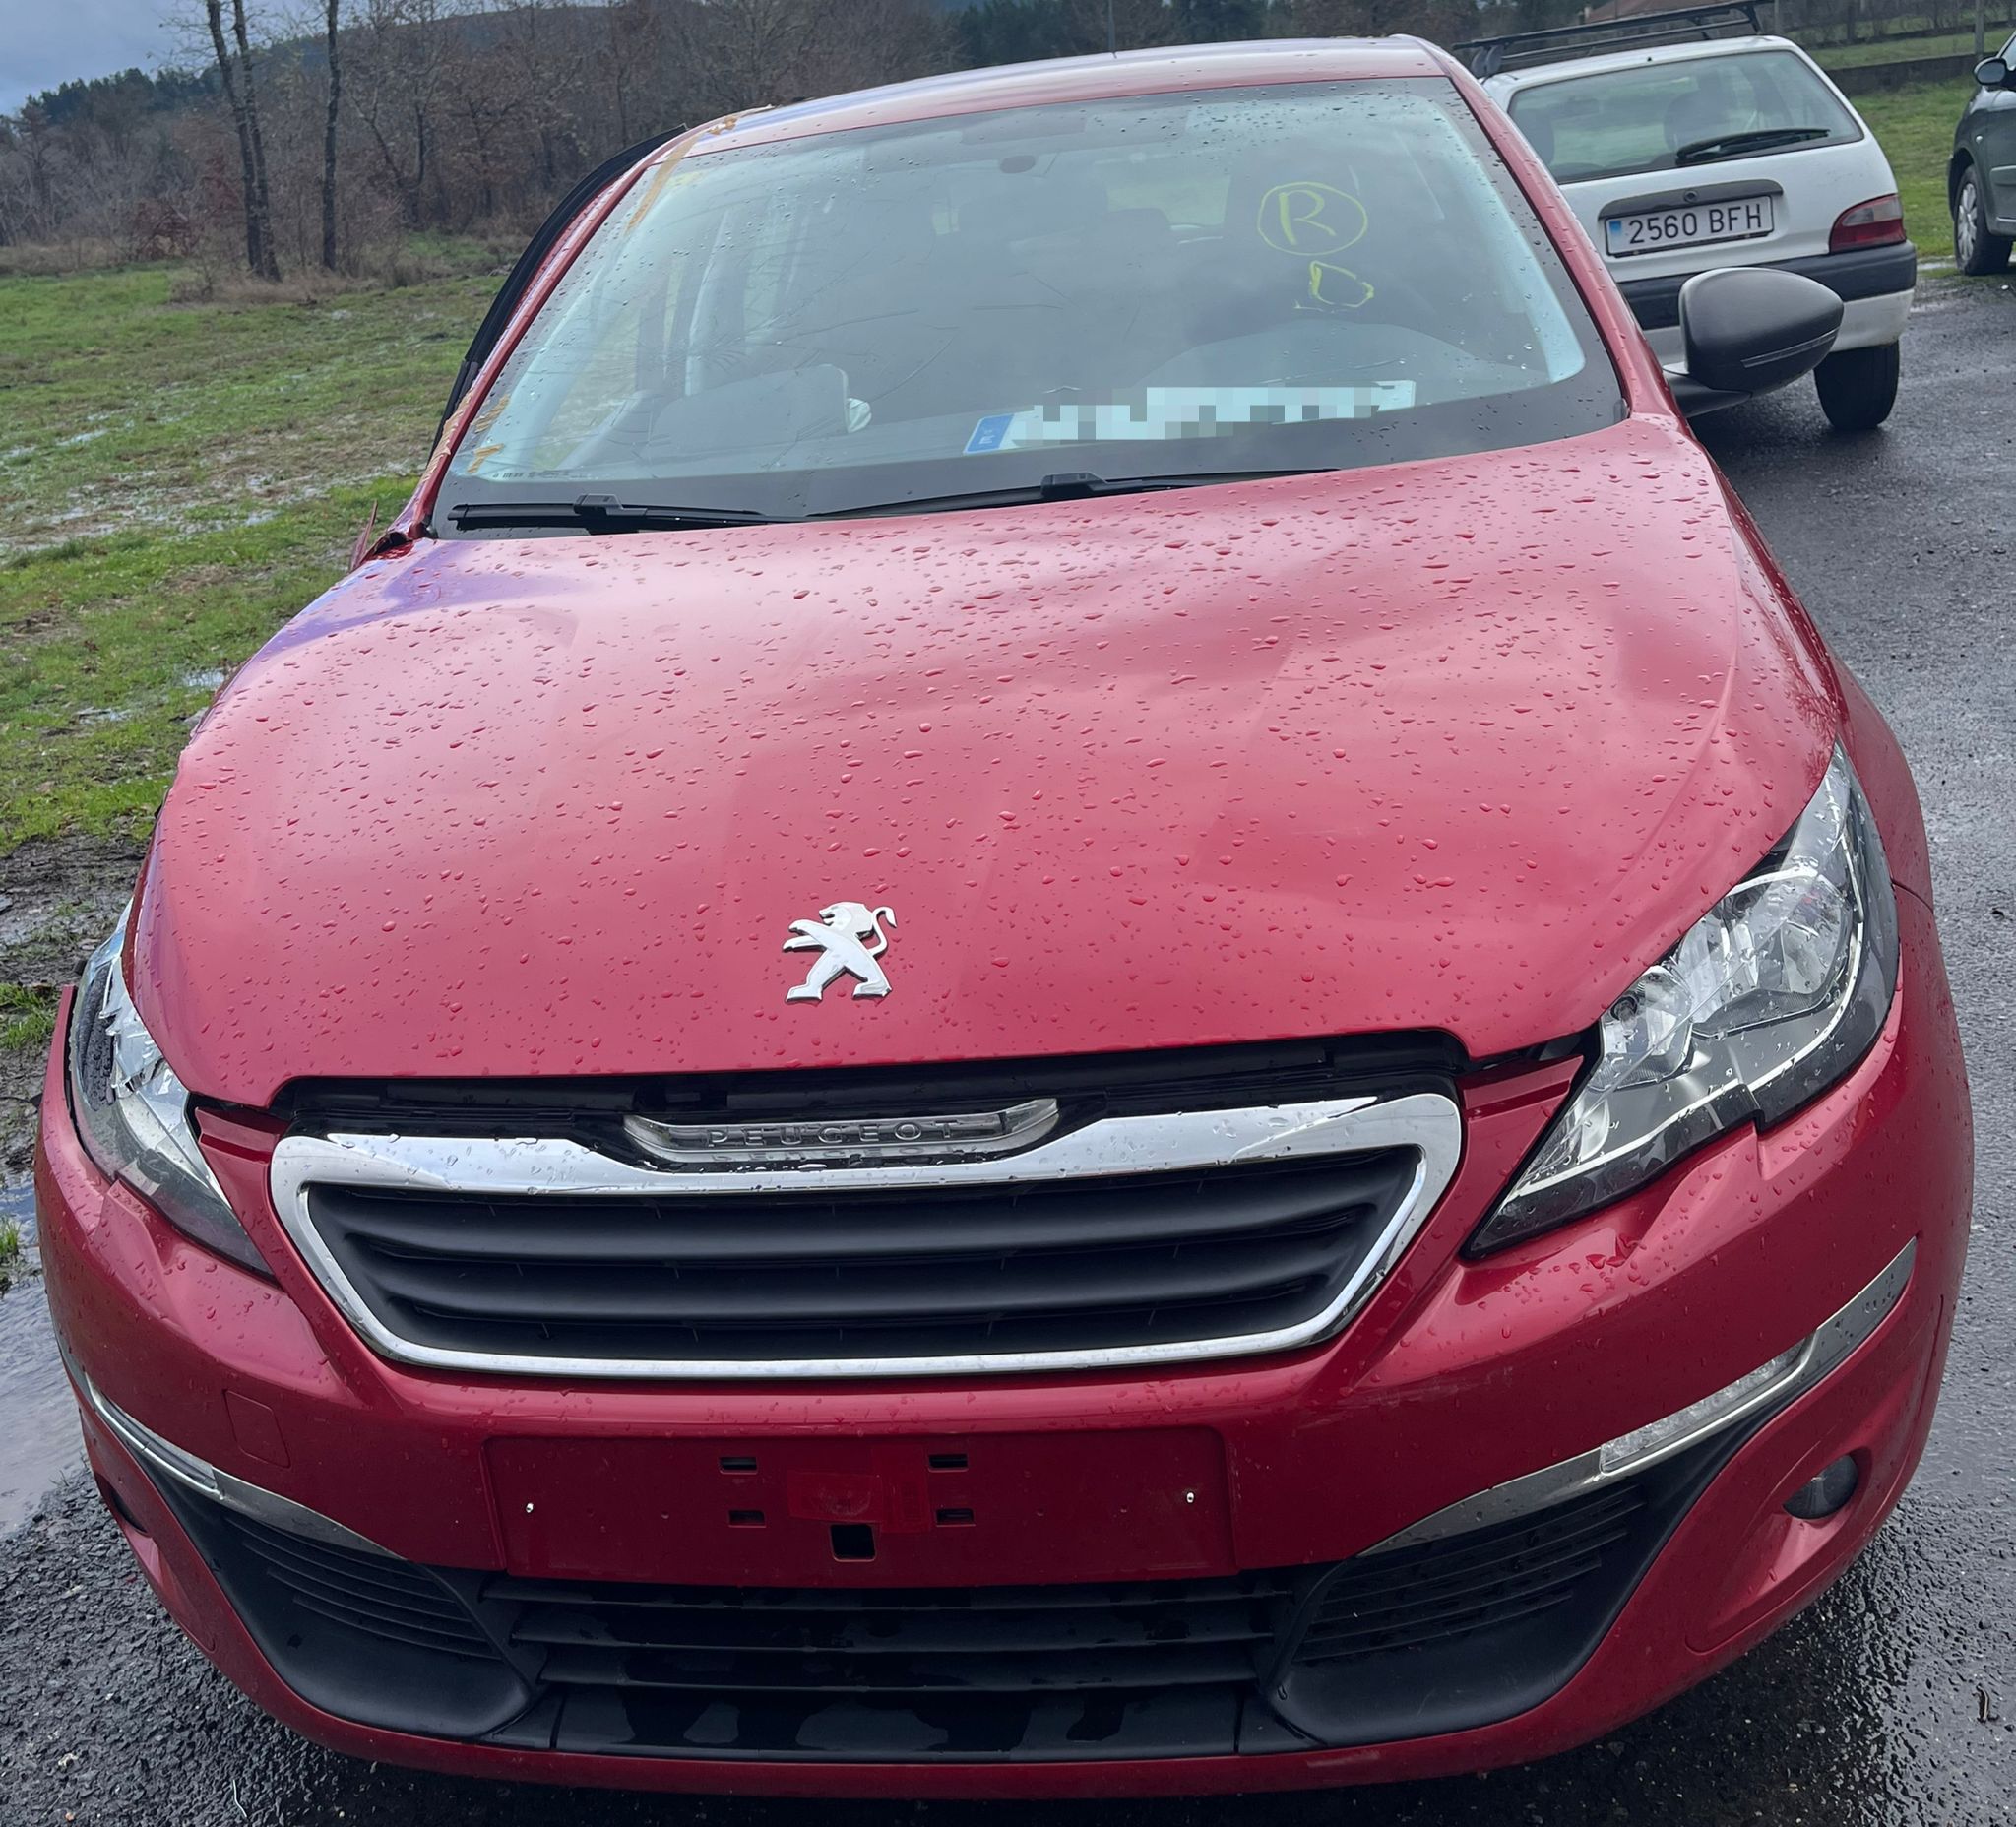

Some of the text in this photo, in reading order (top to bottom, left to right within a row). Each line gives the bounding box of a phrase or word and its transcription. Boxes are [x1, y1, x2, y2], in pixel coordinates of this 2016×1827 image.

[1279, 189, 1337, 246] R
[1628, 203, 1762, 244] 2560 BFH
[706, 1119, 960, 1148] PEUGEOT
